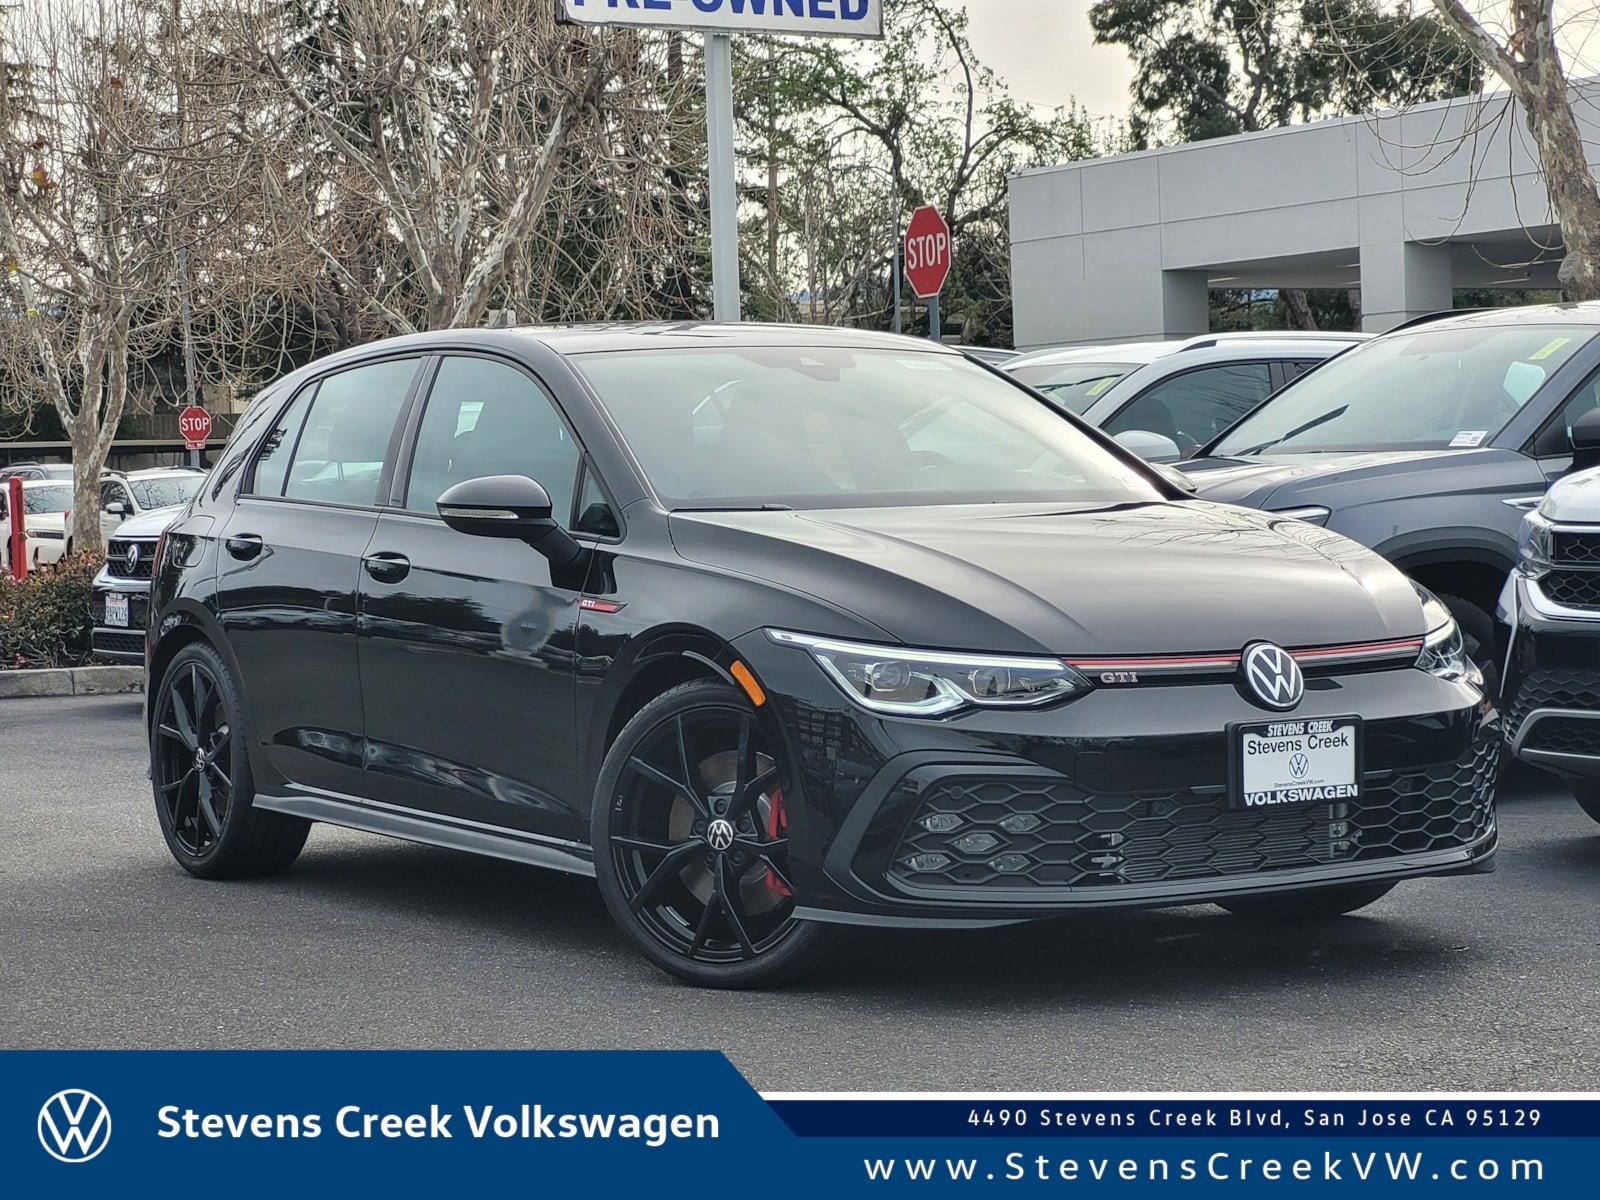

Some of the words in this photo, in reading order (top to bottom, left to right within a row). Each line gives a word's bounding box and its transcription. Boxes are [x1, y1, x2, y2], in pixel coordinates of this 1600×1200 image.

[908, 233, 946, 269] STOP
[181, 417, 209, 431] STOP
[582, 599, 596, 607] GTI
[1100, 671, 1139, 684] GTI
[1245, 642, 1305, 708] VW
[1267, 722, 1304, 737] STEVENS
[1308, 720, 1333, 734] CREEK
[1247, 739, 1302, 755] Stevens
[1307, 732, 1349, 749] Creek
[1288, 752, 1309, 779] VW
[1244, 784, 1359, 807] VOLKSWAGEN
